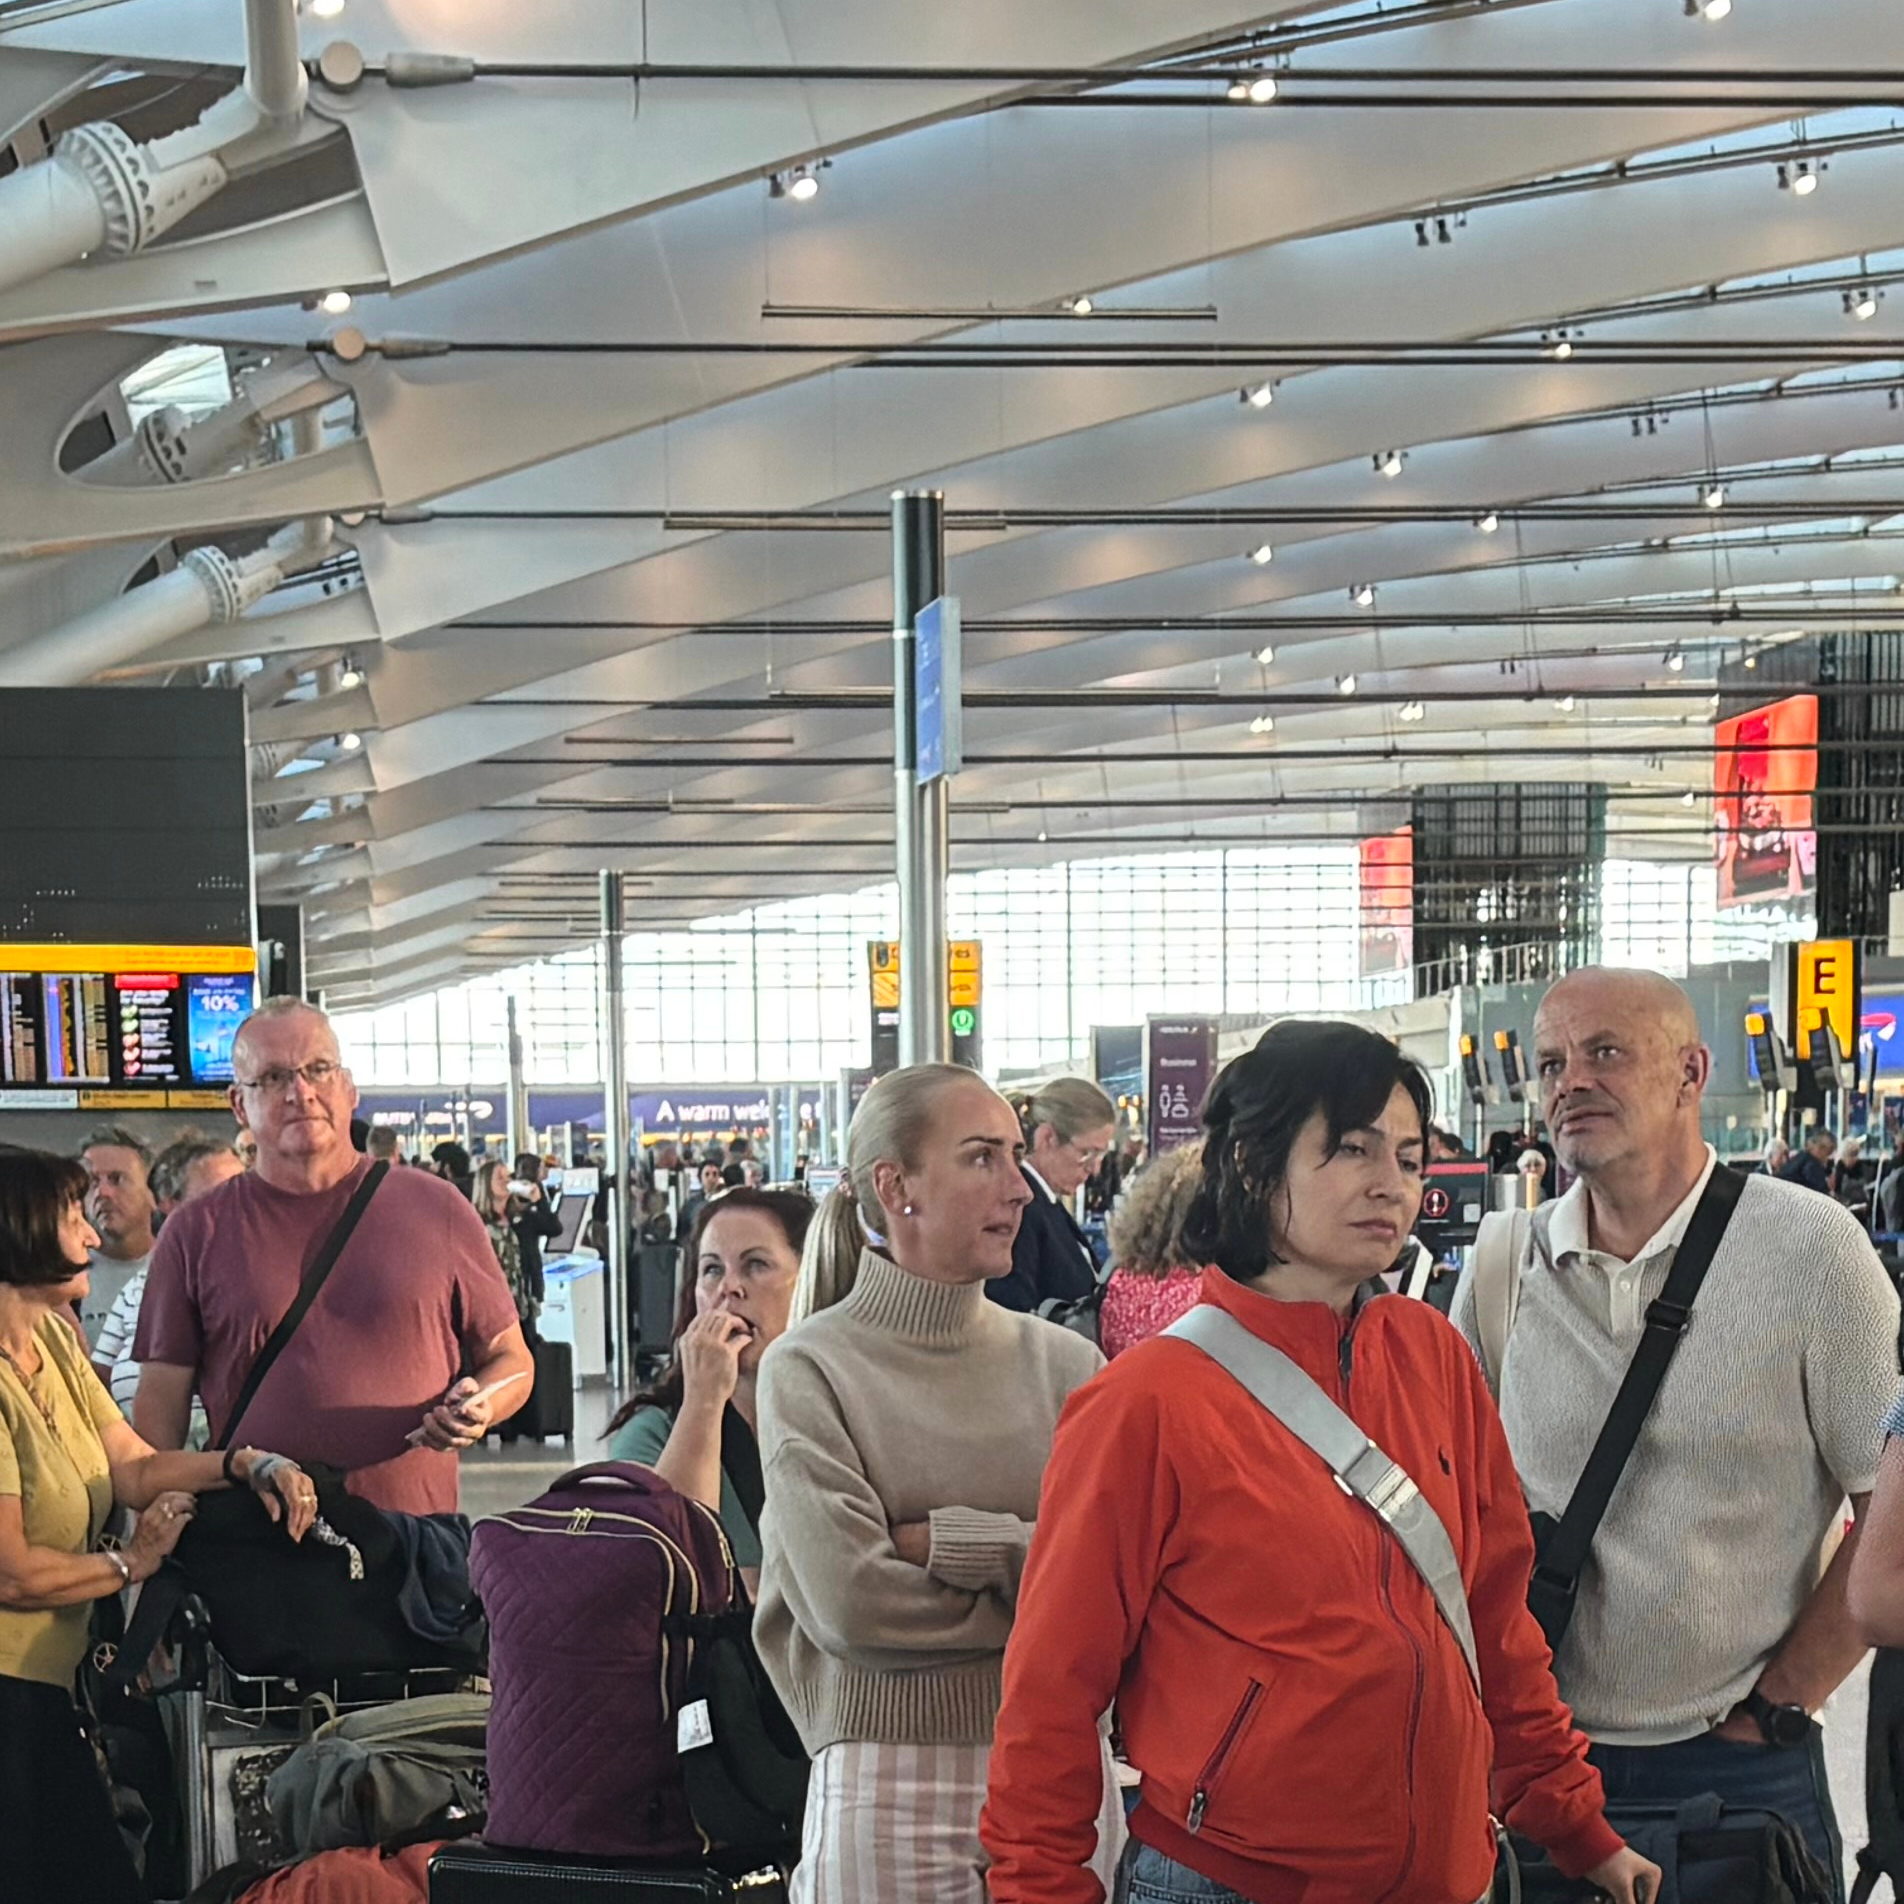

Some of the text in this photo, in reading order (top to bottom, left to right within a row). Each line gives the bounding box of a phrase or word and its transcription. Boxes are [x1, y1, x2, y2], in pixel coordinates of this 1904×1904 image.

[1813, 956, 1837, 995] E
[200, 995, 239, 1012] 10%
[655, 1100, 675, 1122] A
[677, 1103, 730, 1122] warm
